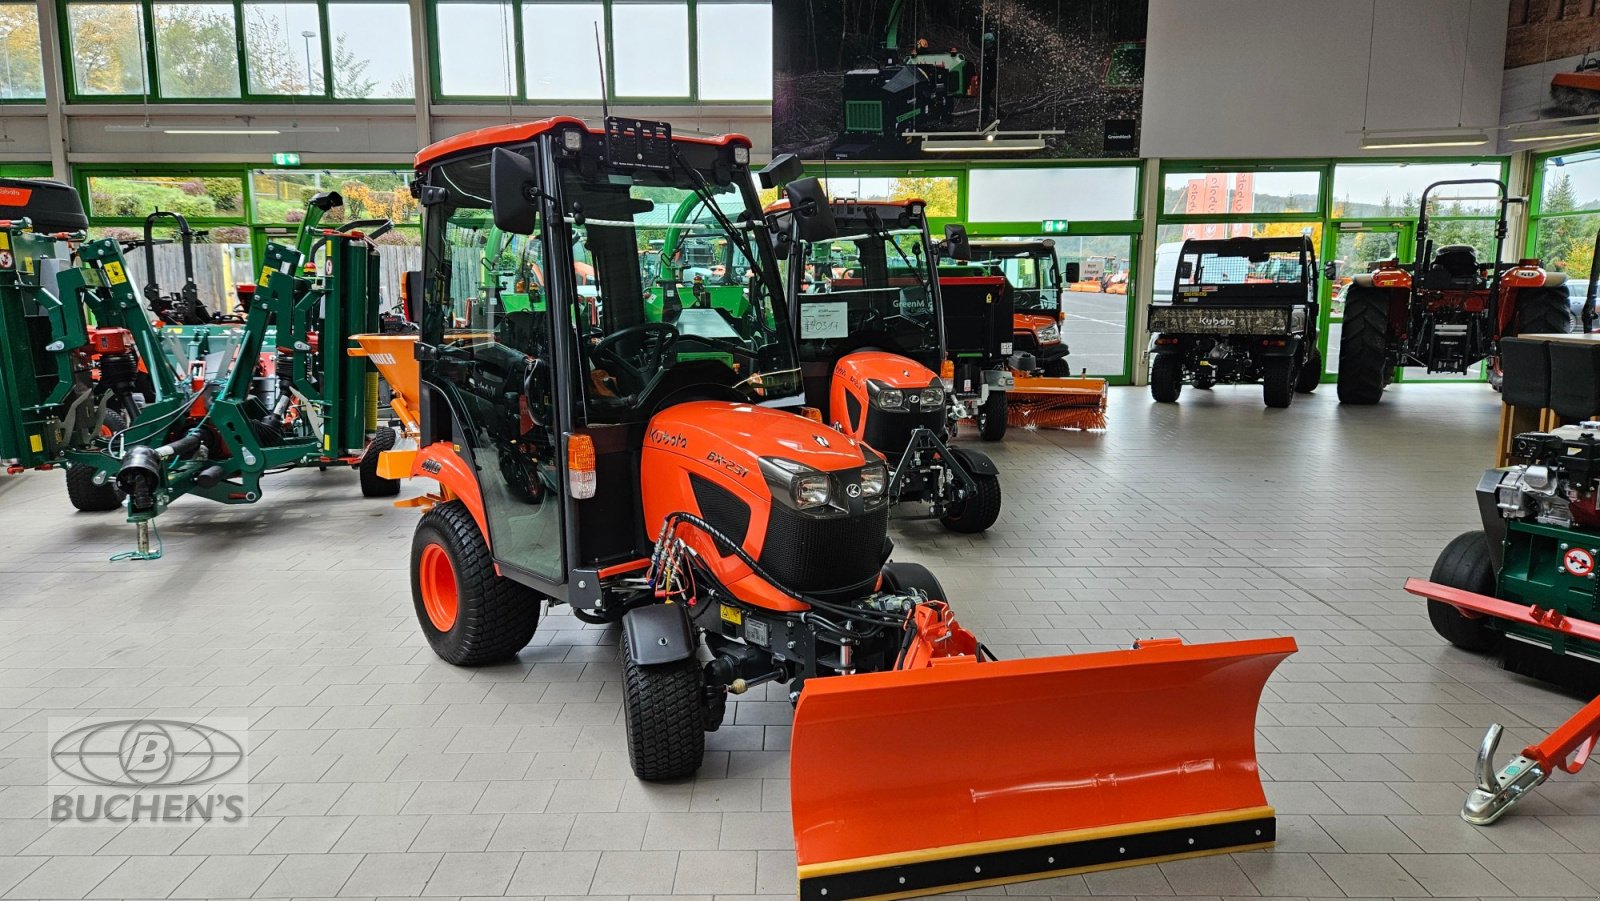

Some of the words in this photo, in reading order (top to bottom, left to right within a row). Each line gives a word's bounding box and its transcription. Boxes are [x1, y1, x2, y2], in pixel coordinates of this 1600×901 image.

[1200, 316, 1235, 326] Kubota
[368, 353, 397, 365] AUCH
[649, 428, 687, 449] Kubota
[706, 451, 749, 478] BX-231
